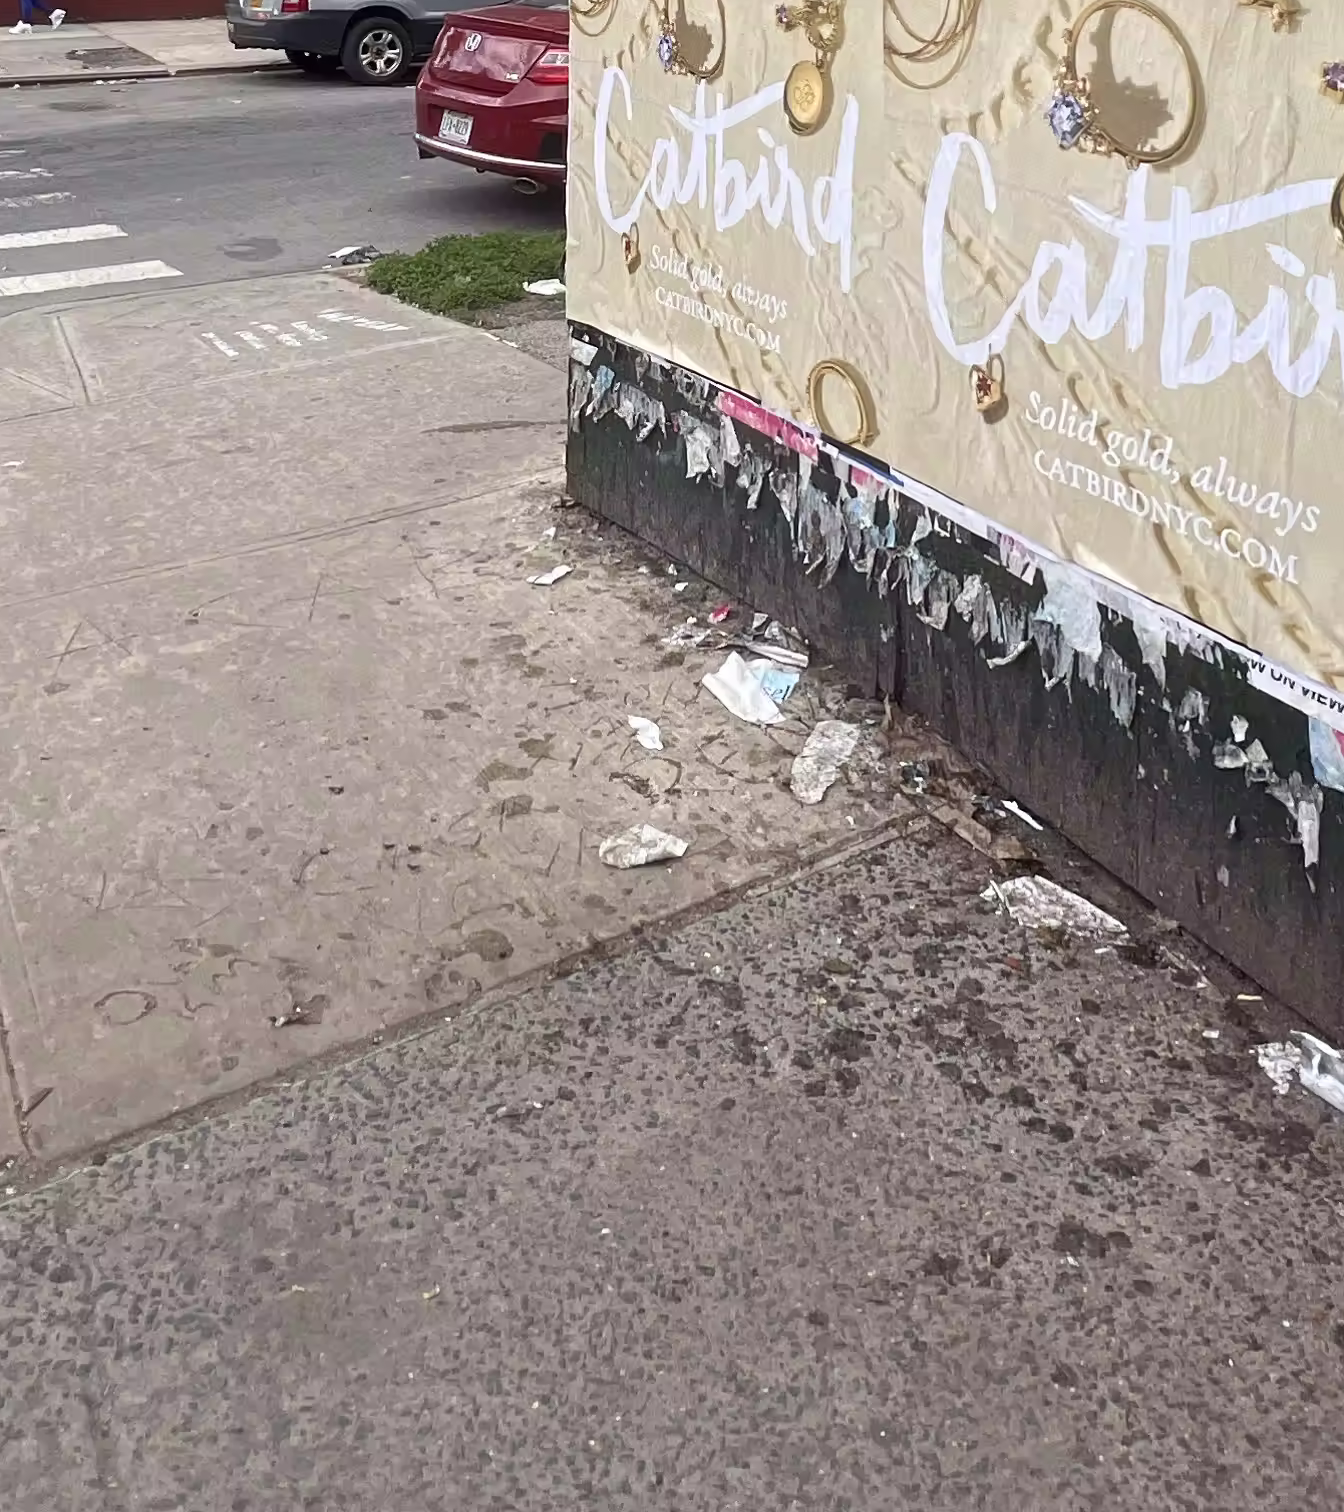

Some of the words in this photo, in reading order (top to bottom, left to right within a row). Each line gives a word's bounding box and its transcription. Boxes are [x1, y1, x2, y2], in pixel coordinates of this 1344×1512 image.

[594, 67, 859, 294] Catbird
[650, 245, 689, 279] Solid
[690, 263, 728, 299] gold,
[656, 286, 781, 354] CATBIRDNYC.COM
[1025, 390, 1098, 446] Solid
[1101, 428, 1180, 484] gold,
[1190, 456, 1321, 537] always
[1033, 448, 1299, 585] CATBIRDNYC.COM
